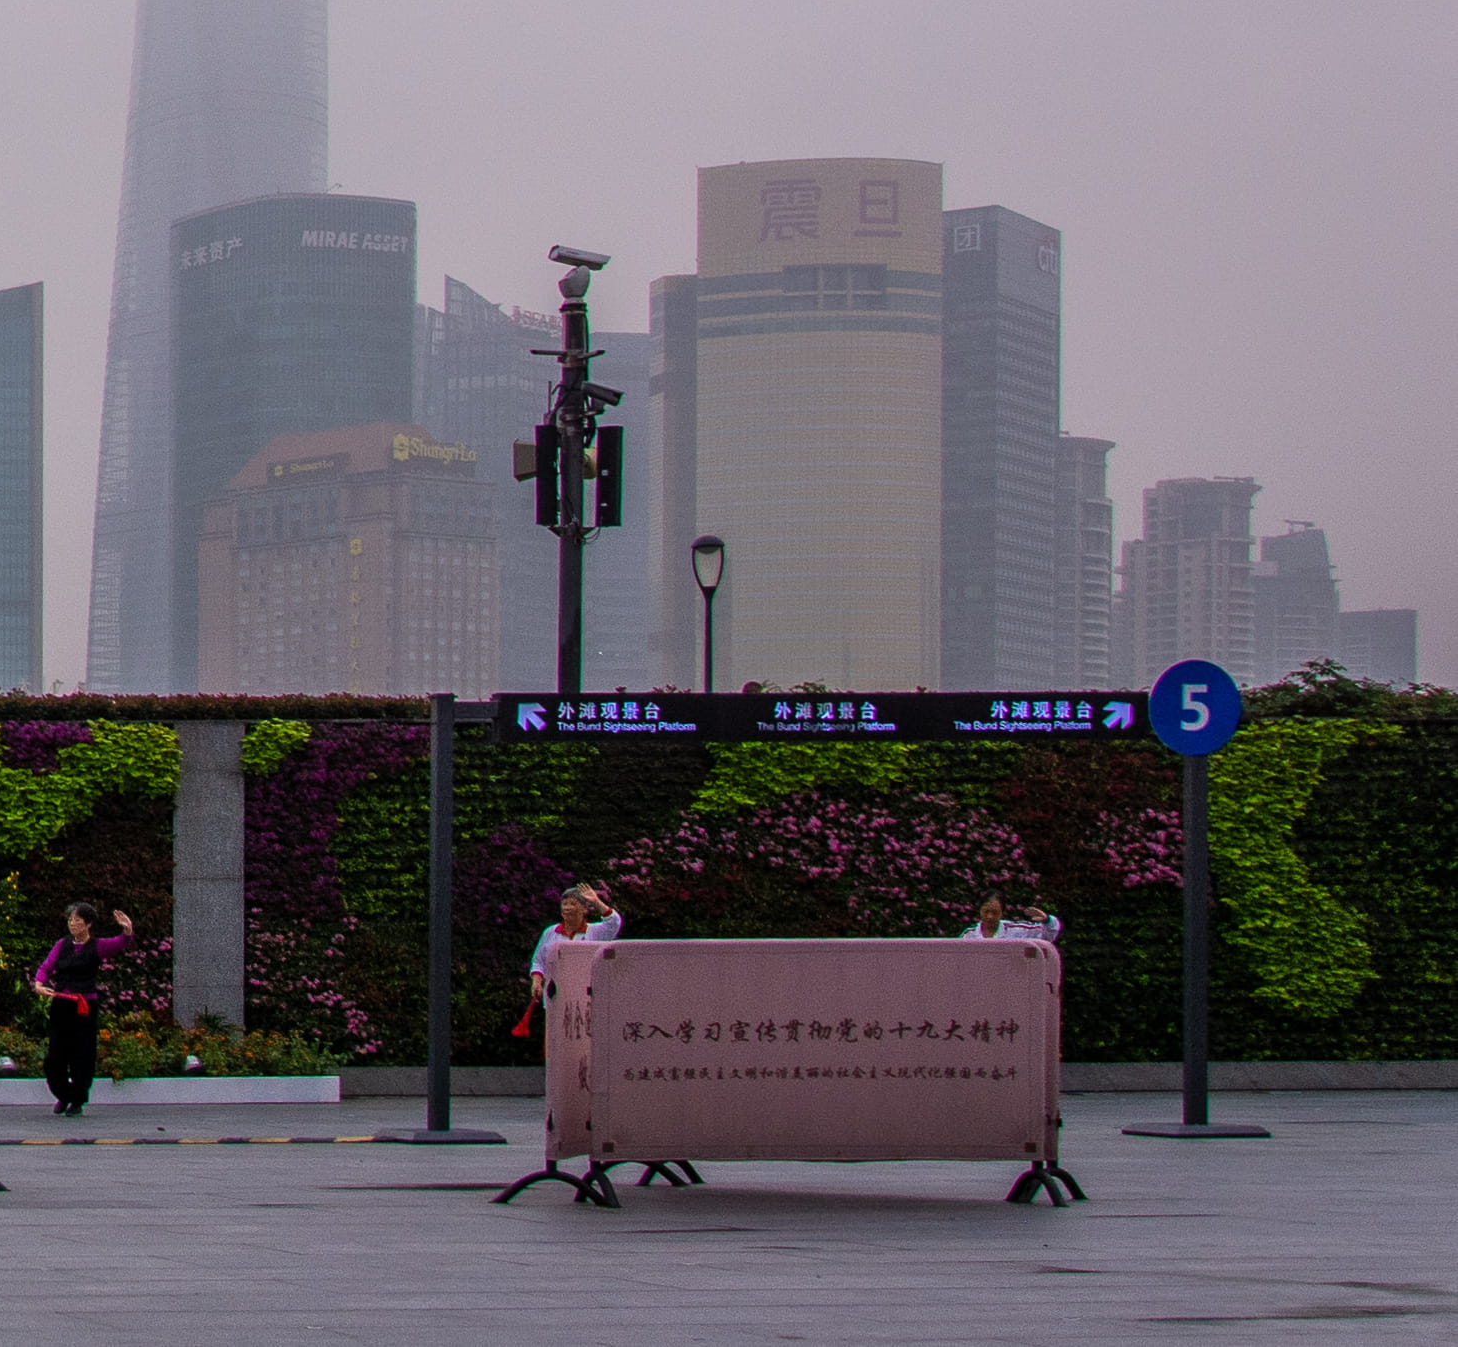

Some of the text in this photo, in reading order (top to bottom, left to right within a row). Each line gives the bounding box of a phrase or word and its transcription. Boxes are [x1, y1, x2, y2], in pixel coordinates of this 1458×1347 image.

[759, 178, 903, 242] 震旦
[300, 230, 410, 254] MIRAE ASSET
[558, 701, 663, 720] 外滩观景台
[774, 701, 878, 720] 外滩观景台
[989, 700, 1093, 719] 外滩观景台
[1179, 683, 1211, 732] 5
[557, 721, 697, 733] The Bund Sightseeing Platform
[757, 721, 896, 733] The Bund Sightseeing Platform
[954, 720, 1093, 732] The Bund Sightseeing Platform
[622, 1017, 1020, 1045] 深入学习宣传贯彻党的十九大精神
